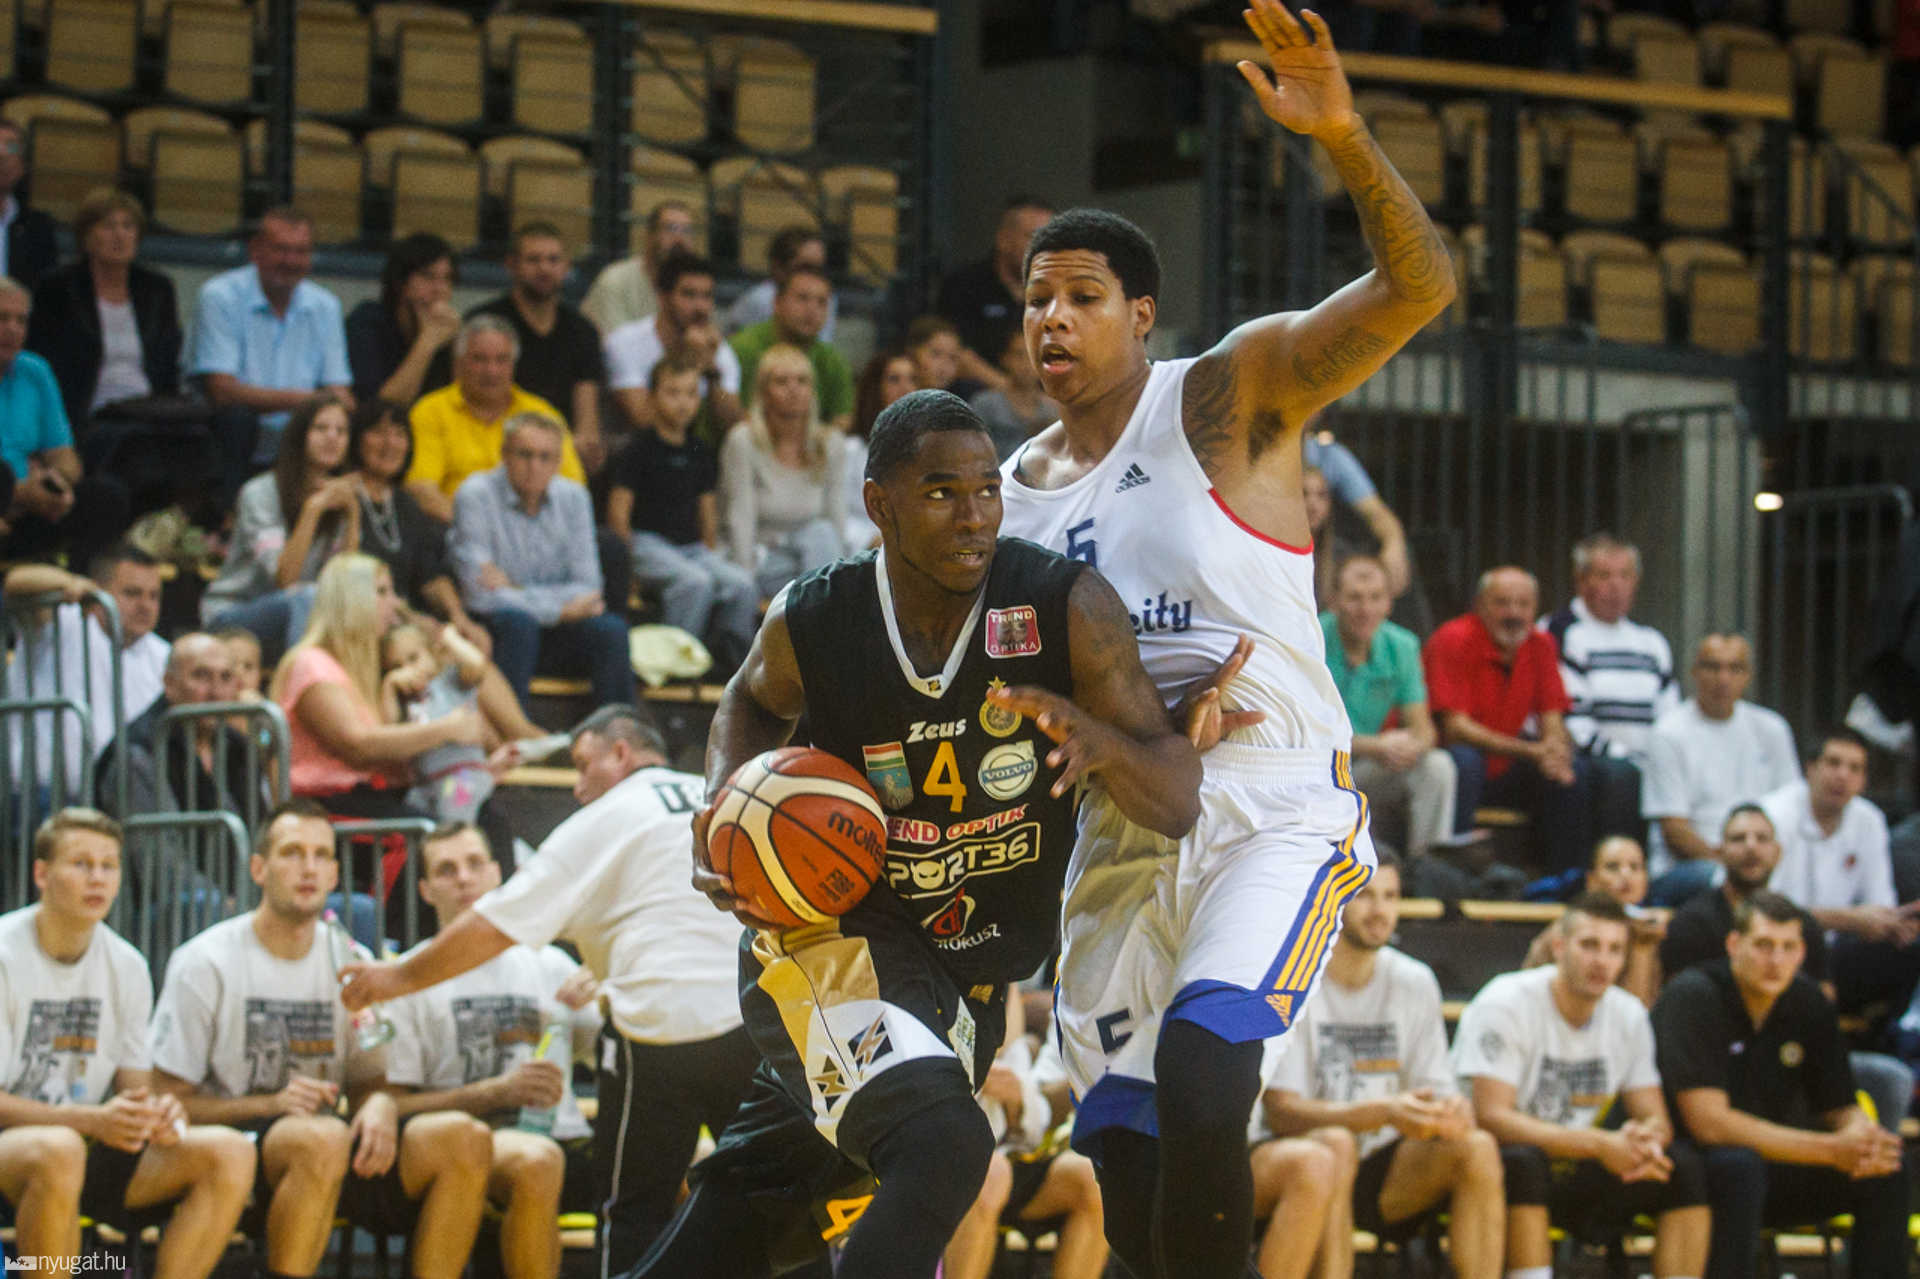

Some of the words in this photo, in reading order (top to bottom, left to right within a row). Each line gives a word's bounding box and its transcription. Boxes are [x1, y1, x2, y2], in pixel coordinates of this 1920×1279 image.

[990, 610, 1033, 624] TREND
[906, 718, 967, 744] Zeus
[922, 740, 967, 813] 4
[983, 761, 1033, 781] VOLVO
